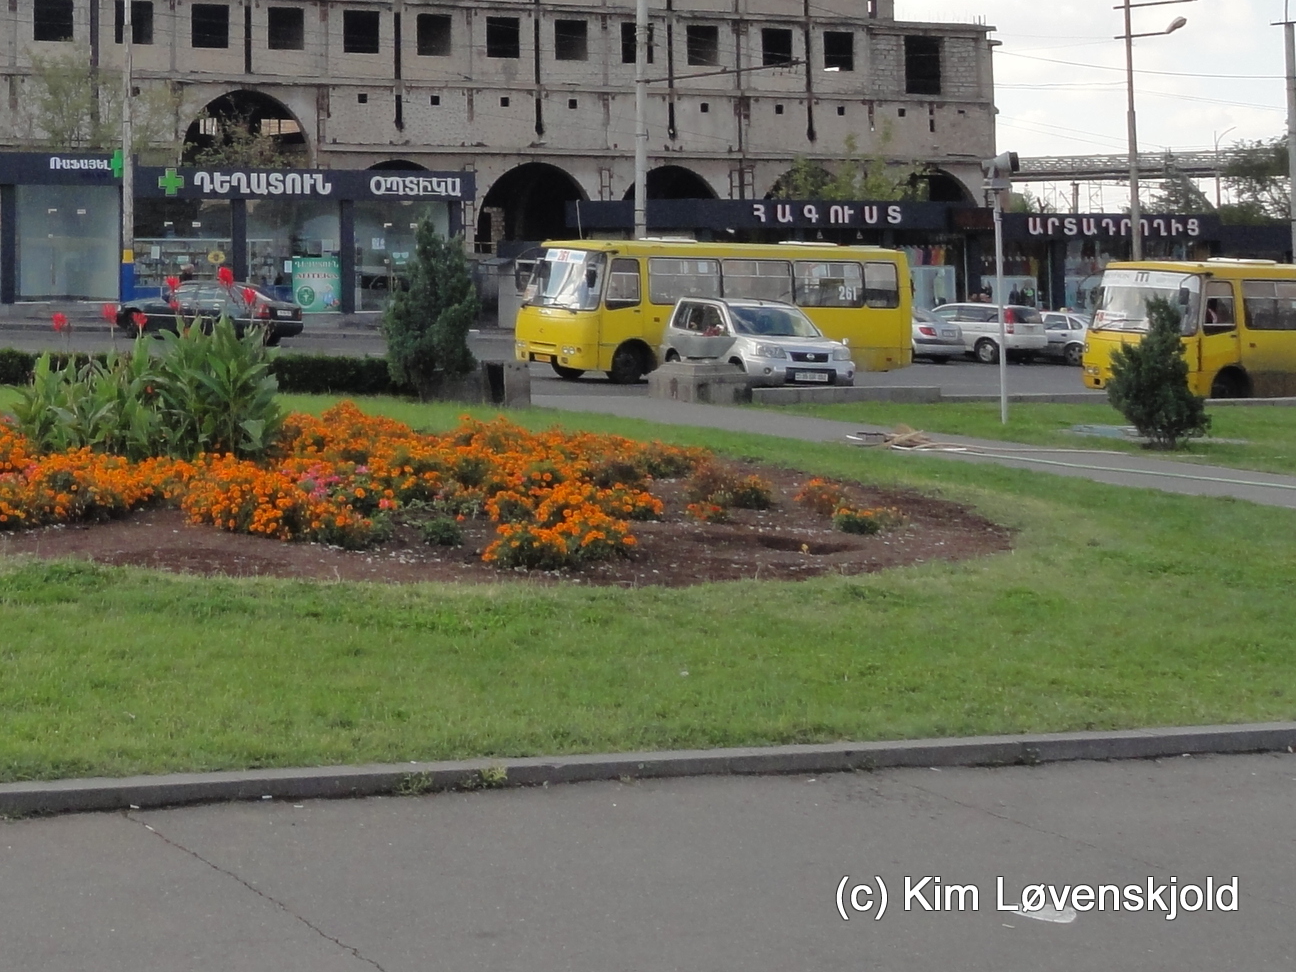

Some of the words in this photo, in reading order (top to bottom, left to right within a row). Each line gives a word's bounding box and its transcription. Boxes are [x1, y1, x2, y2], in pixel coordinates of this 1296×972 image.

[194, 171, 332, 195] ԴԵՂԱՏՈՒՆ
[370, 176, 461, 197] ՕՊՏԻԿԱ
[838, 285, 857, 301] 261
